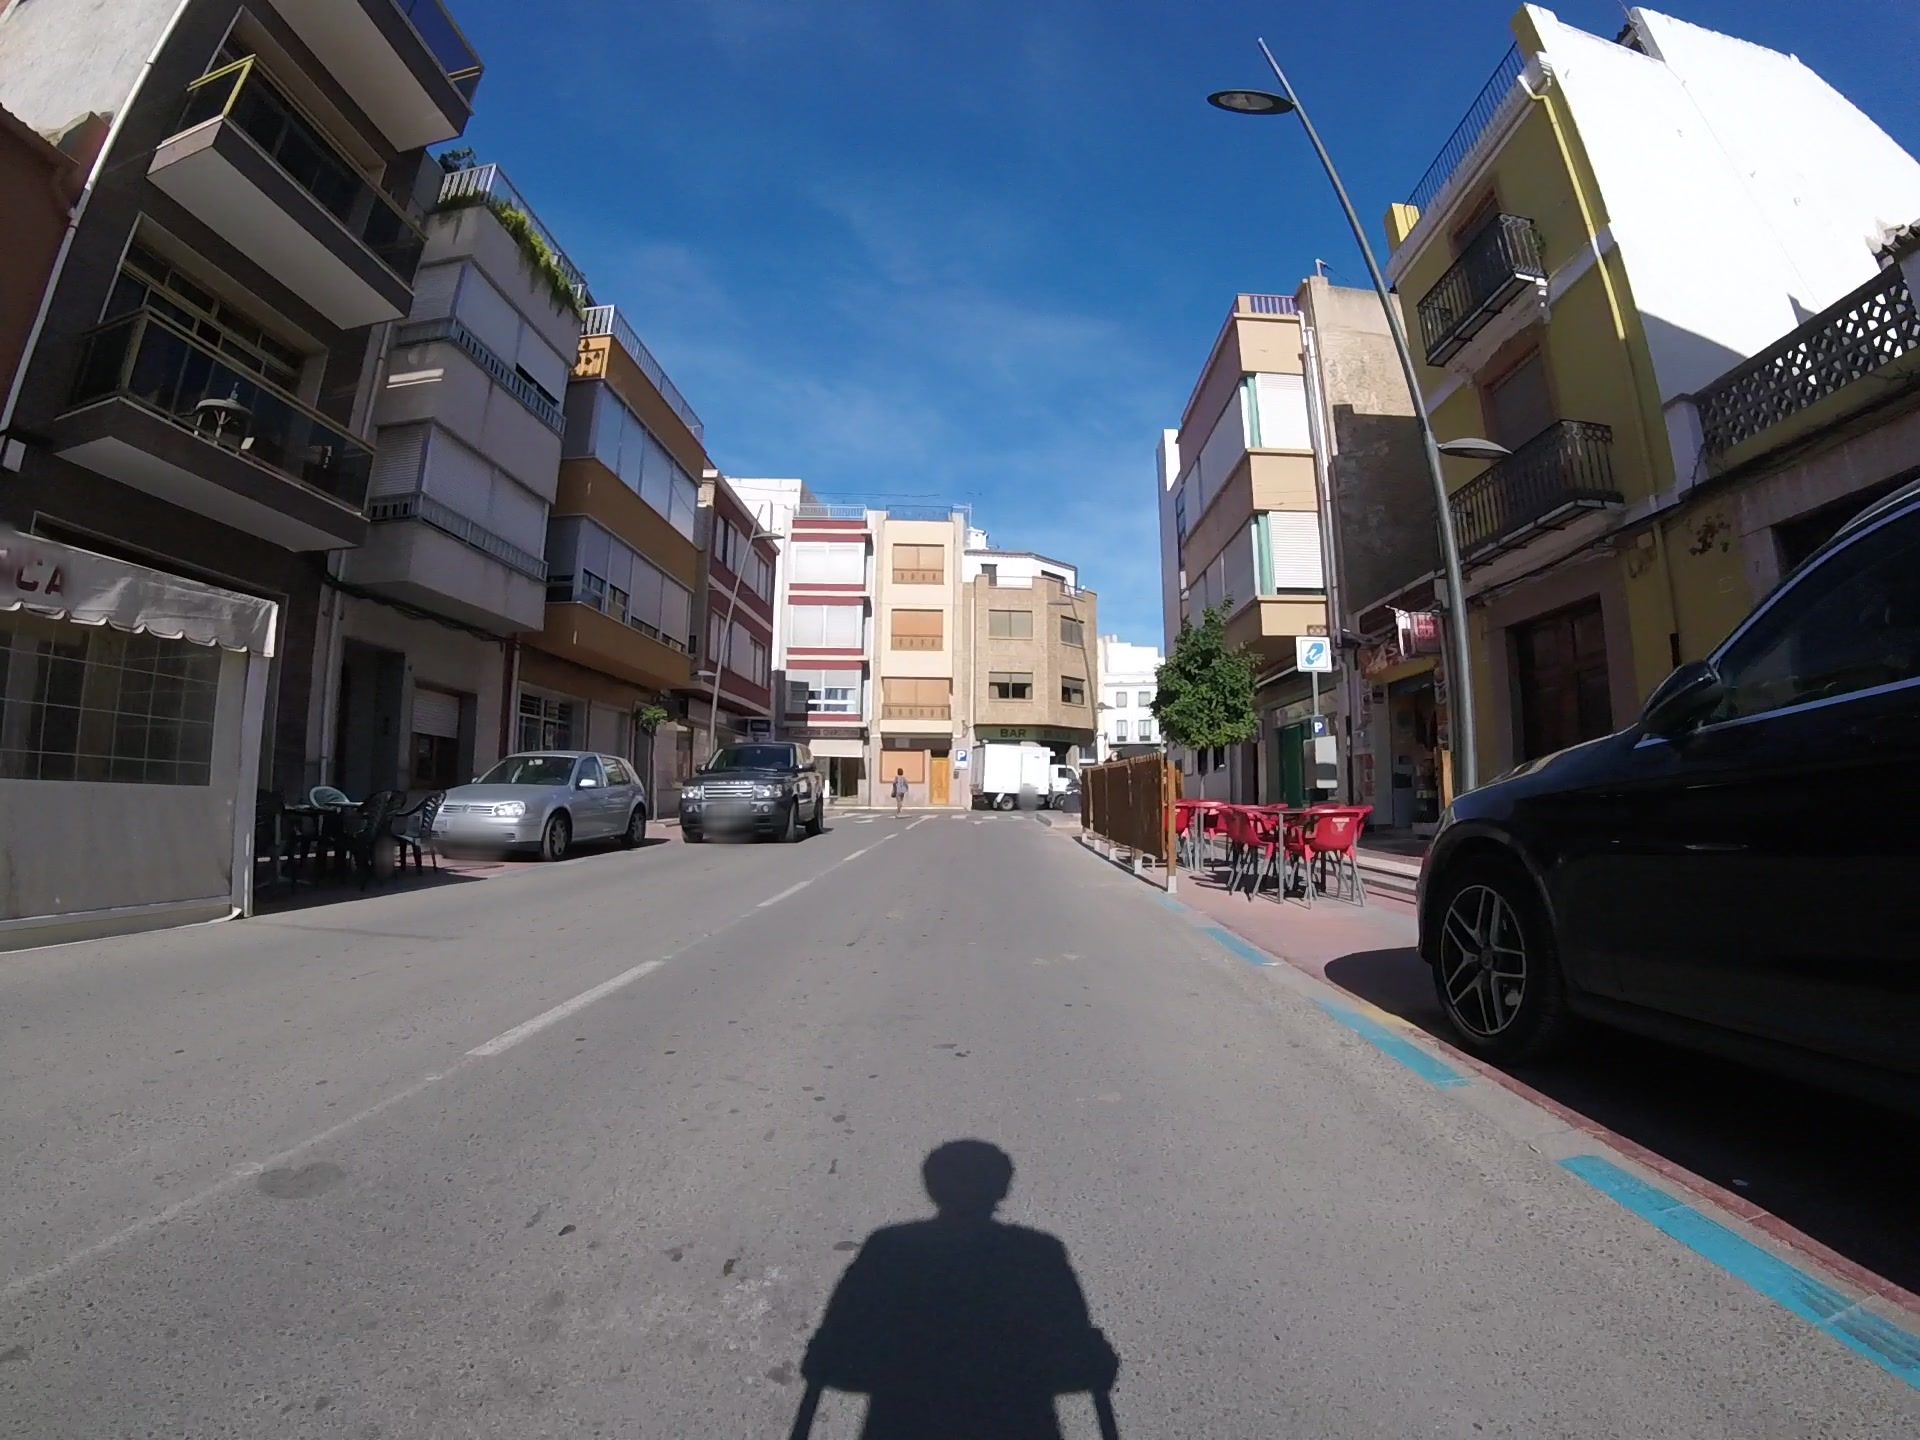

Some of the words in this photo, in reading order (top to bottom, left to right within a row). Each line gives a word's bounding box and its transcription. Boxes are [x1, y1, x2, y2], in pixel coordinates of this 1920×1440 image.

[1314, 721, 1323, 733] P
[999, 728, 1027, 738] BAR
[956, 750, 966, 761] P
